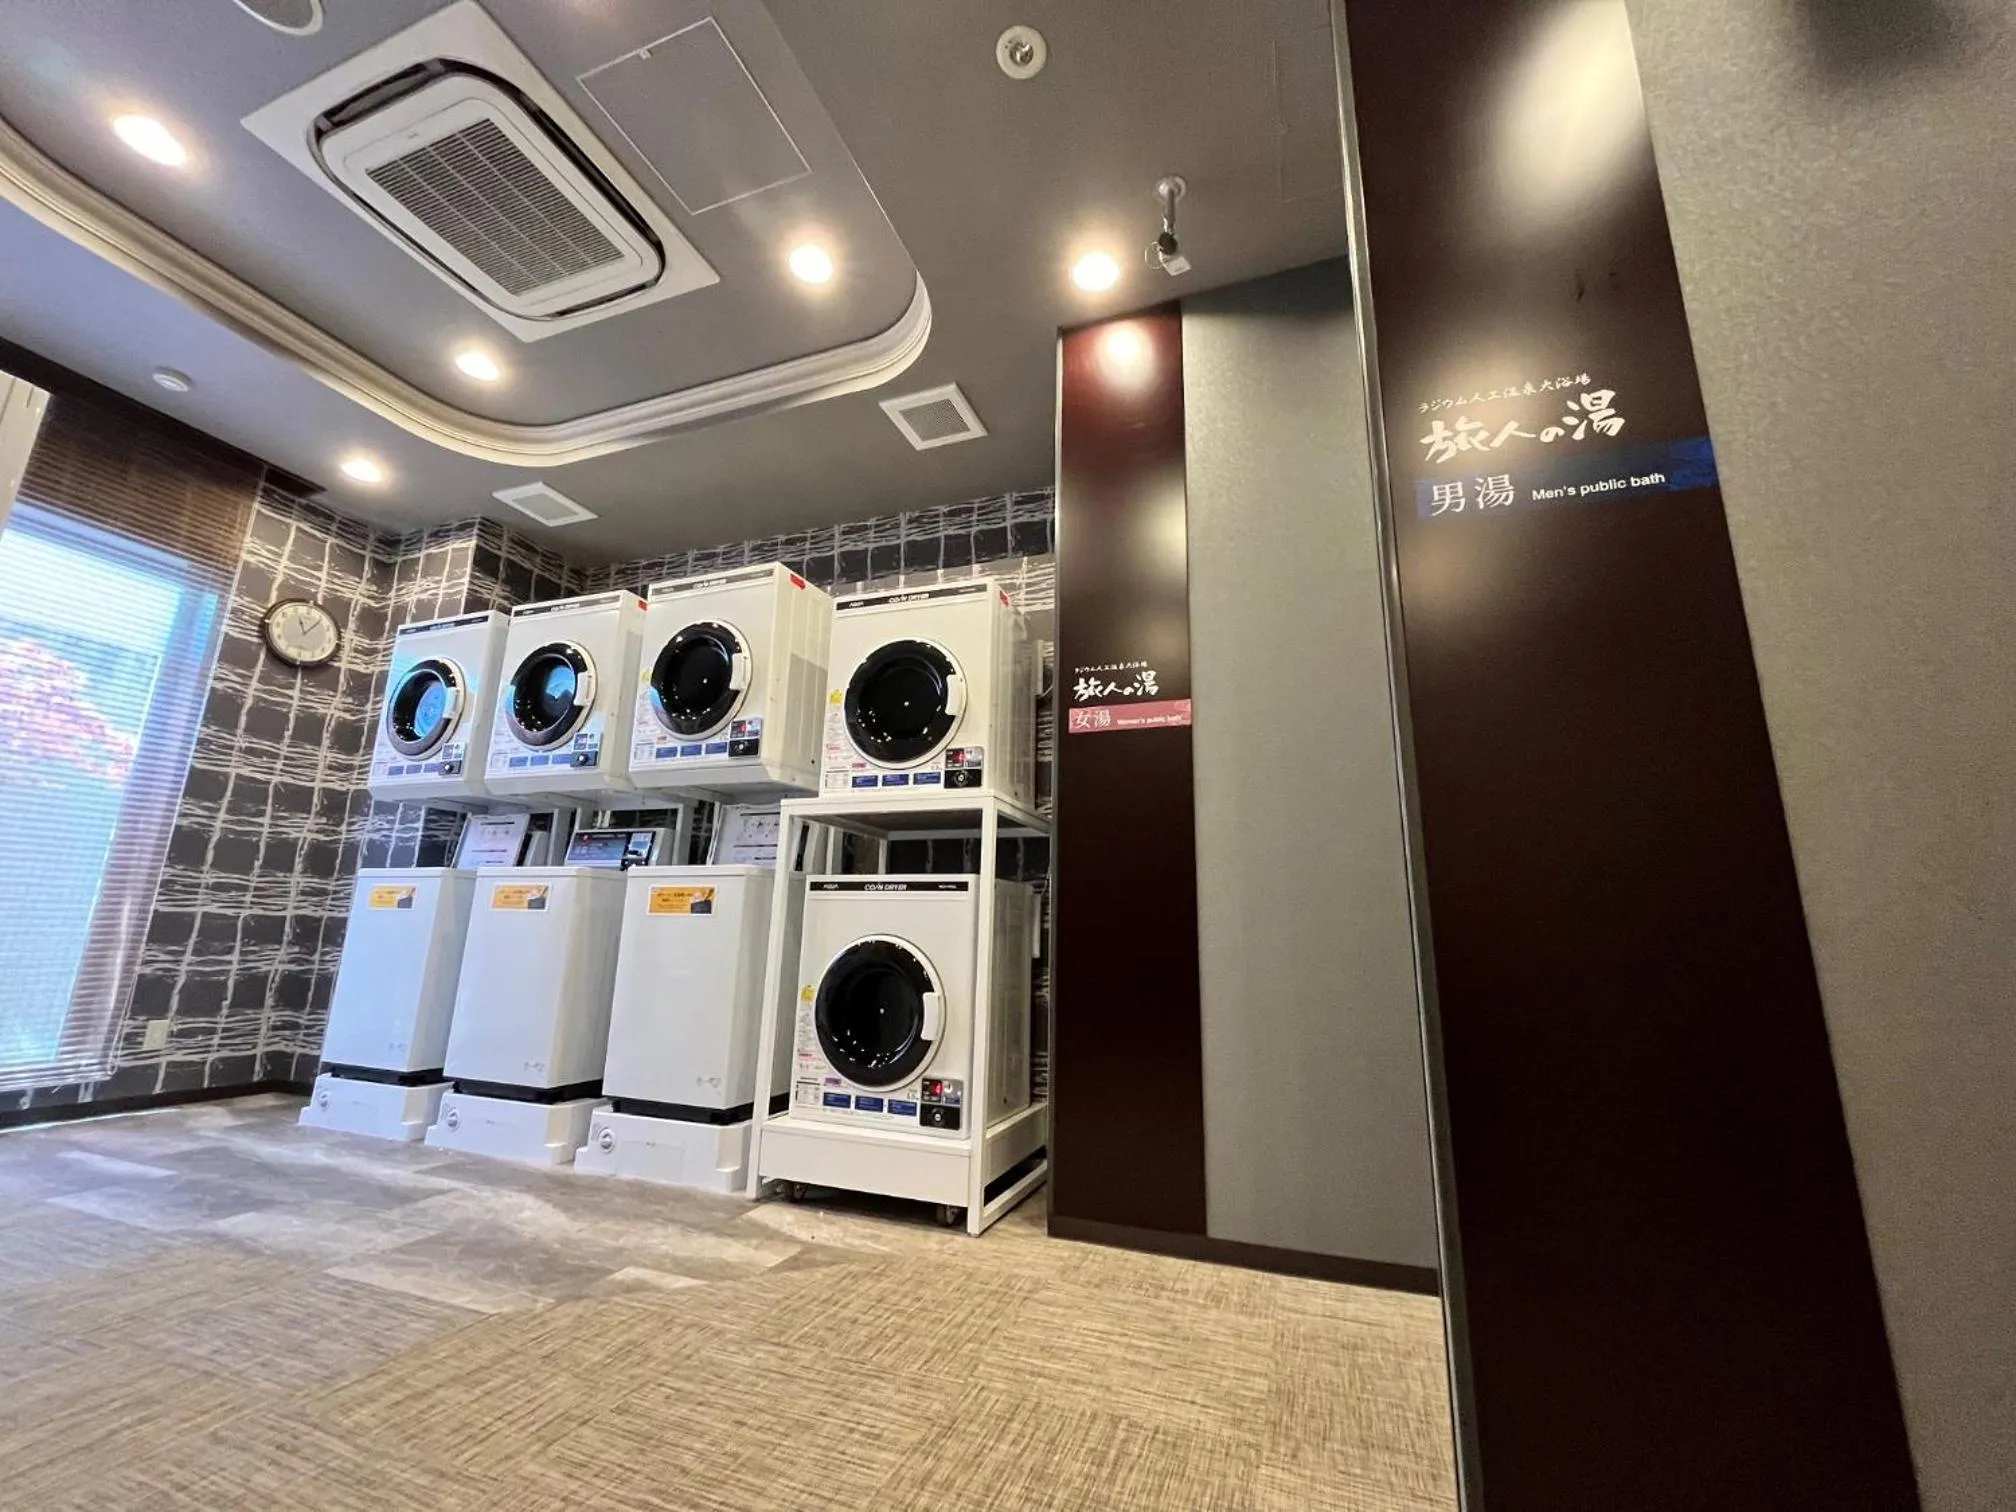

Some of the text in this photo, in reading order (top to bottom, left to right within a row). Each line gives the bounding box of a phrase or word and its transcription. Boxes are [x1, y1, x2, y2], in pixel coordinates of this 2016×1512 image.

[1418, 373, 1592, 413] ラジウム人工温泉大浴場
[1420, 388, 1626, 464] 旅人の湯
[1430, 473, 1516, 516] 男湯
[1531, 471, 1667, 502] Men's public bath
[1073, 670, 1160, 702] 旅人の湯
[1075, 709, 1112, 729] 女湯
